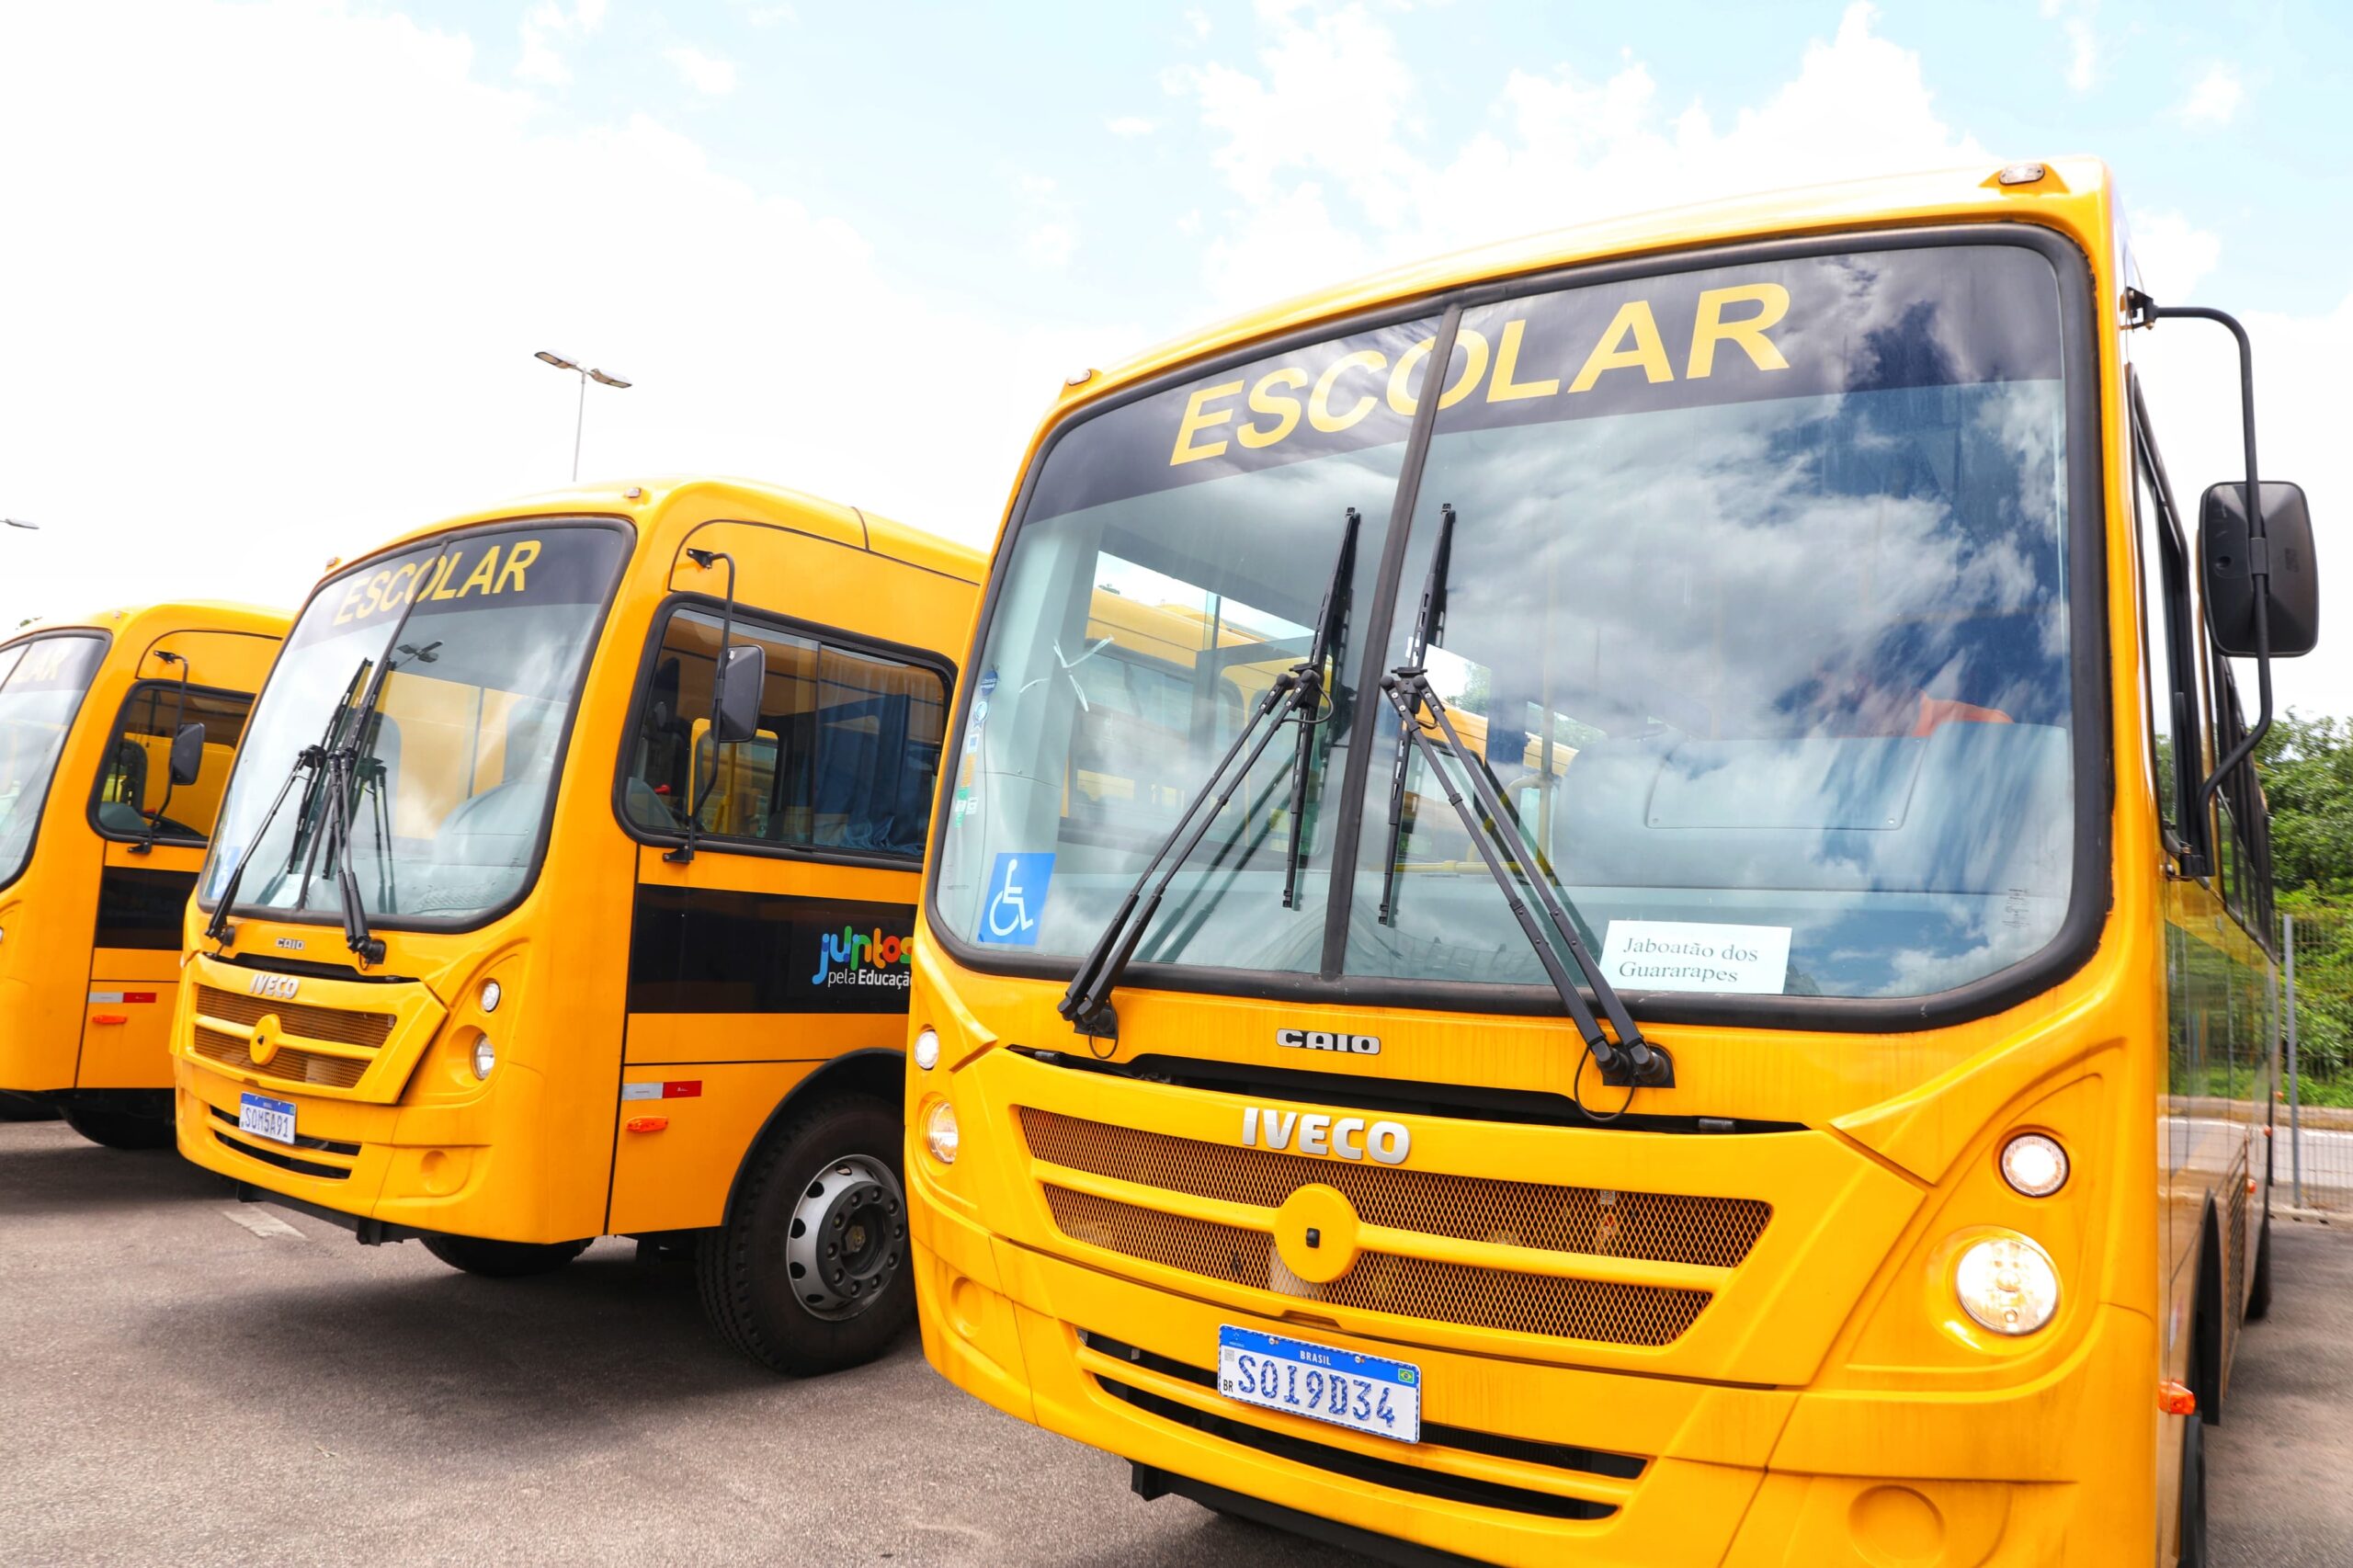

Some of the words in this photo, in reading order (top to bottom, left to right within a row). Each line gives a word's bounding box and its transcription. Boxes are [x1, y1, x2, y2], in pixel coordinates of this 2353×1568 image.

[1169, 282, 1791, 466] ESCOLAR
[333, 540, 542, 627] ESCOLAR
[277, 938, 303, 949] CAIO
[1623, 937, 1714, 958] Jaboatão
[1722, 944, 1758, 962] dos
[827, 968, 856, 988] pela
[858, 969, 914, 990] Educaçã
[1619, 961, 1738, 983] Guararapes
[249, 973, 300, 999] IVECO
[1277, 1028, 1381, 1054] CAIO
[1243, 1107, 1411, 1165] IVECO
[1300, 1350, 1332, 1366] BRASIL
[1222, 1379, 1233, 1393] BR
[1238, 1355, 1395, 1428] SOI9D34
